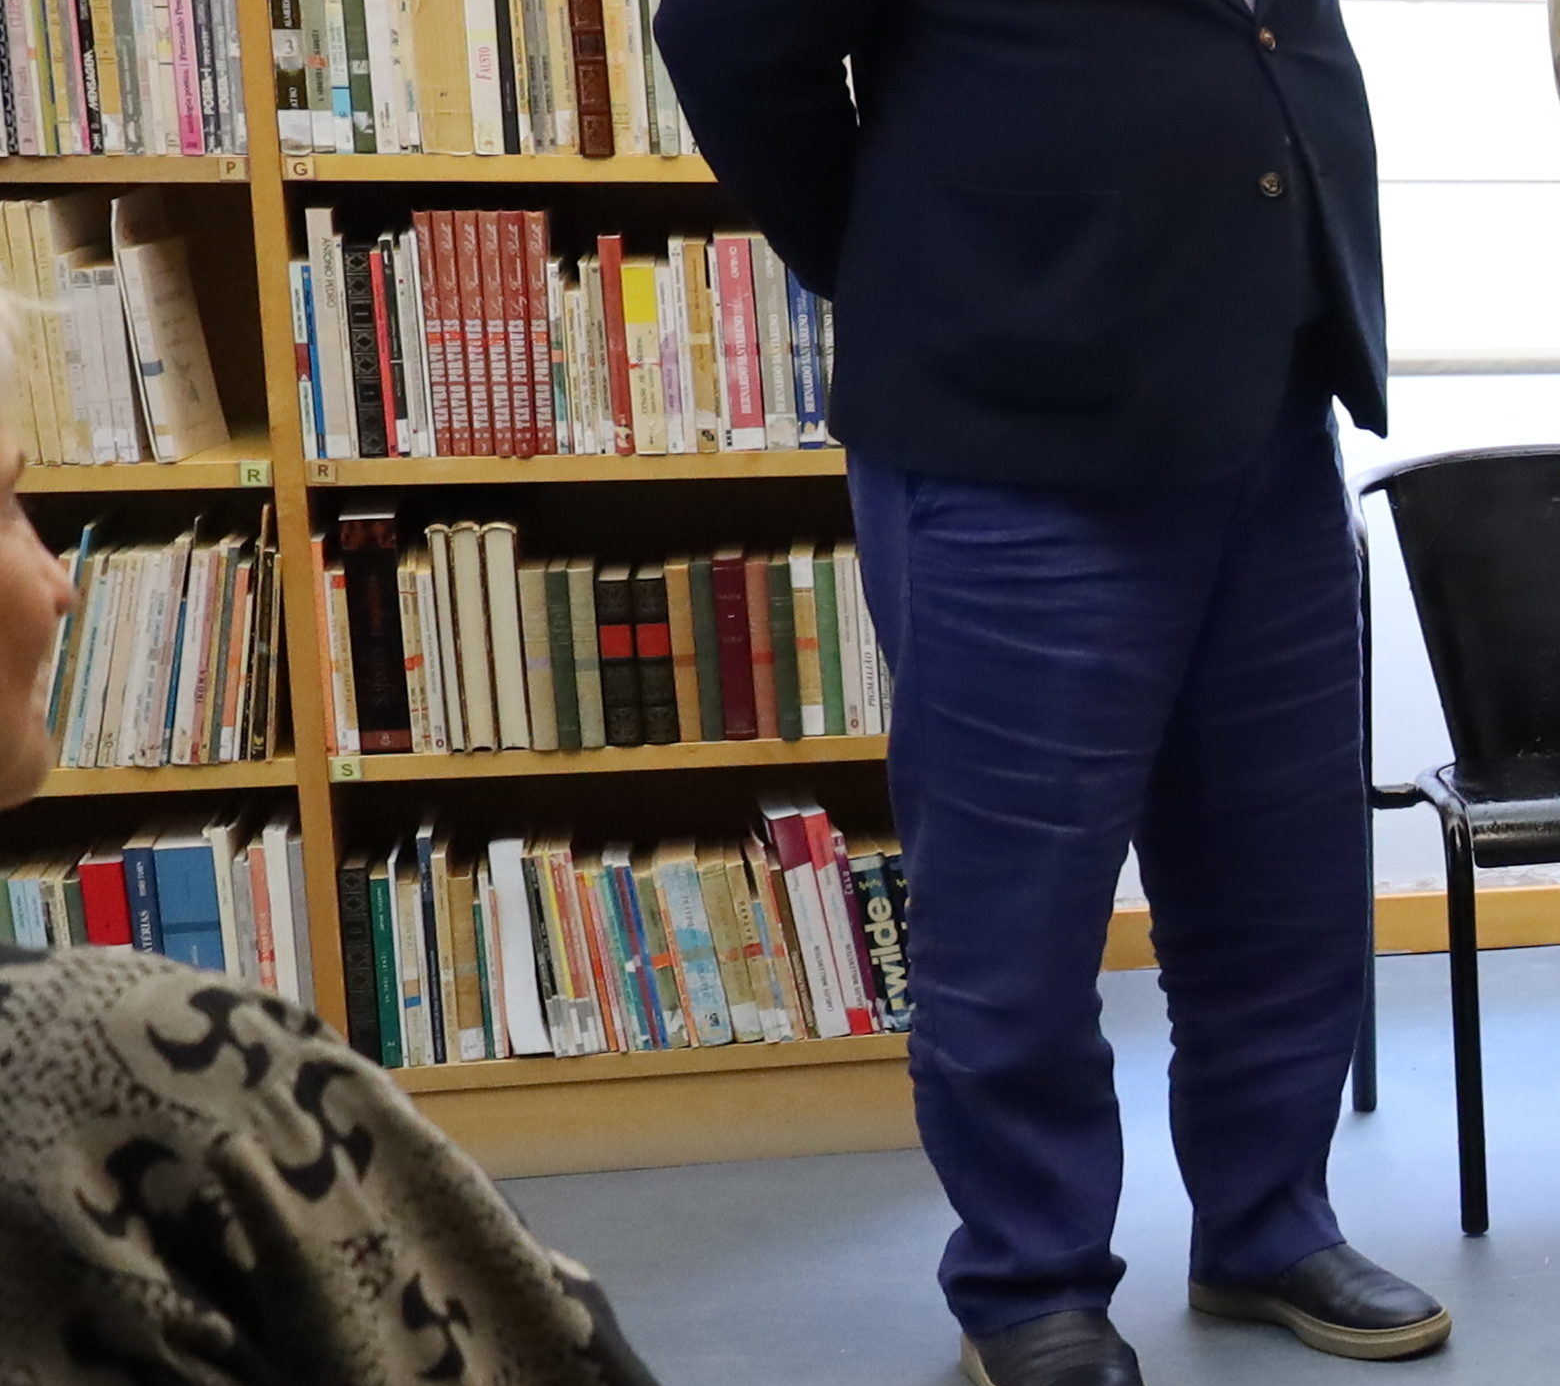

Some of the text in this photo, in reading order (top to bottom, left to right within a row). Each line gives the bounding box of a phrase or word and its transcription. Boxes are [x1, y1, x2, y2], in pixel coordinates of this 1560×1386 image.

[175, 17, 188, 61] Fernando
[82, 49, 100, 111] MENSAGEM
[181, 69, 192, 97] poética
[476, 46, 492, 81] FAUSTO
[184, 97, 194, 134] antologia
[226, 161, 236, 175] P
[293, 161, 308, 177] G
[324, 279, 336, 308] PEDRO
[734, 315, 752, 414] BERNARDO SANTARENO
[768, 313, 786, 413] BERNARDO SANTARENO
[798, 313, 816, 413] BERNARDO SANTARENO
[435, 385, 450, 429] TEATRO
[452, 385, 468, 429] TEATRO
[473, 385, 490, 429] TEATRO
[495, 385, 511, 429] TEATRO
[514, 385, 530, 429] TEATRO
[534, 385, 552, 429] TEATRO
[248, 469, 260, 483] R
[318, 465, 328, 477] R
[865, 651, 877, 707] PIGMALIÃO
[342, 763, 353, 777] S
[846, 943, 859, 985] WALLENSTEIN
[862, 896, 908, 999] wilde
[812, 944, 832, 1012] CARLOS WALLENSTEIN
